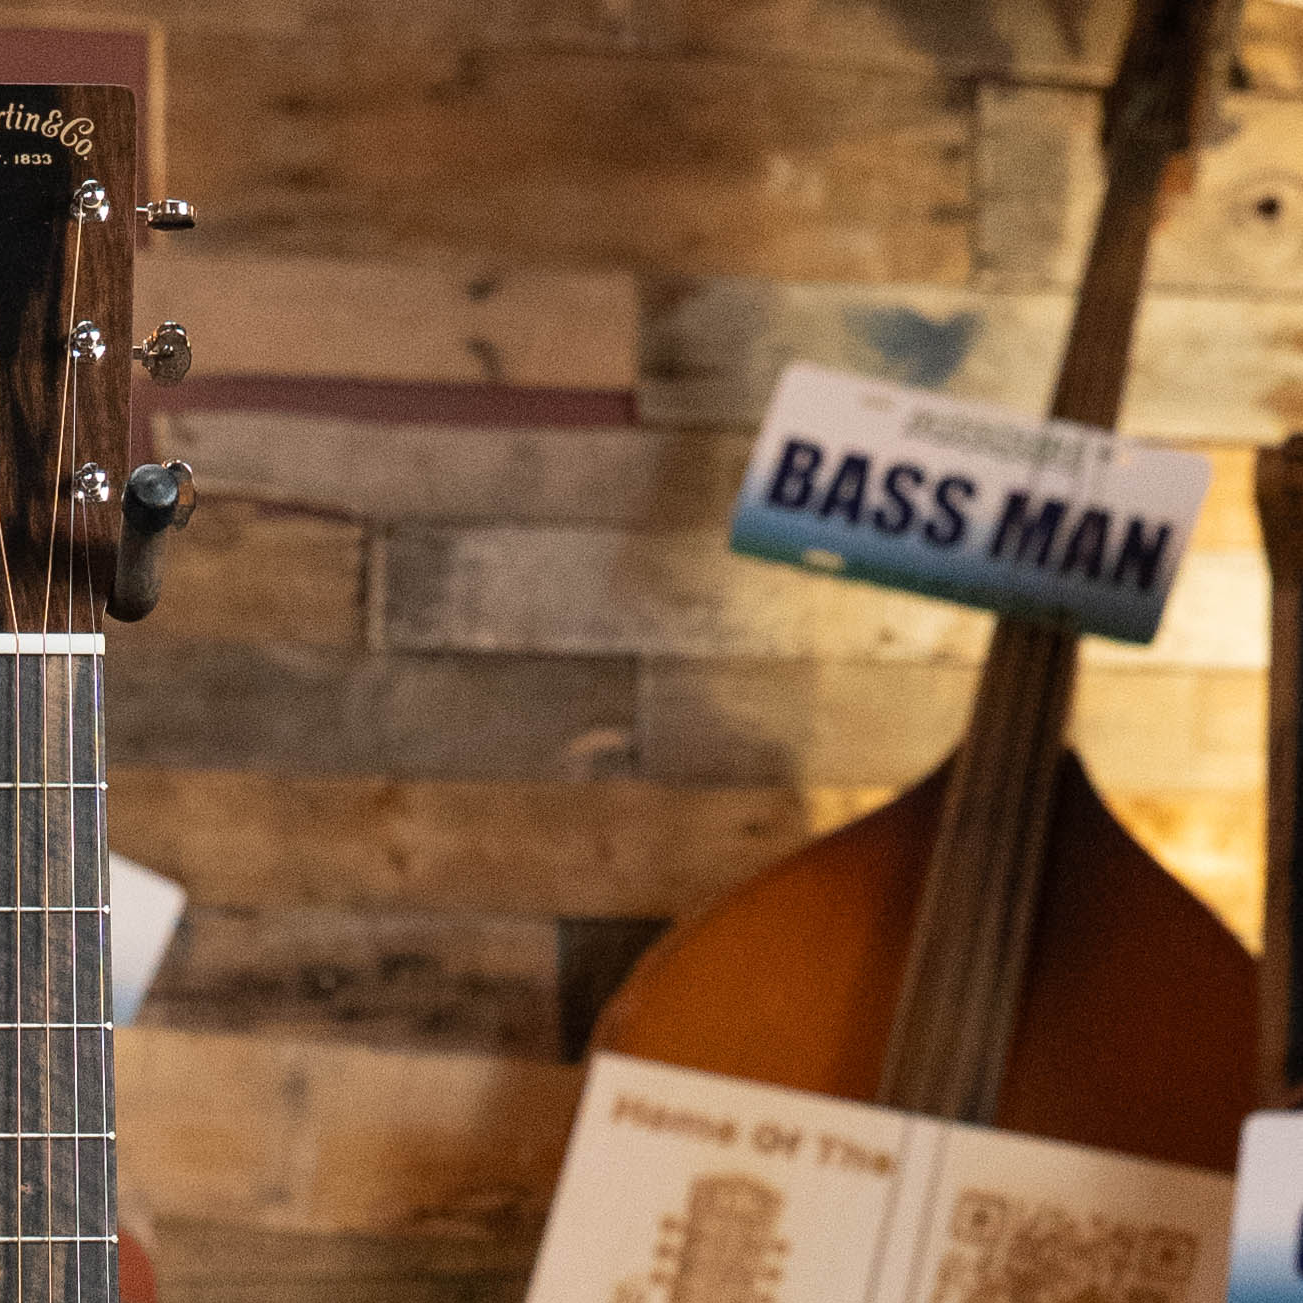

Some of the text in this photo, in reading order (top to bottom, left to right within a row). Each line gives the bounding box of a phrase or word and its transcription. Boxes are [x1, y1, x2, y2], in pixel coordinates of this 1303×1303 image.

[14, 153, 53, 165] 1833
[766, 434, 976, 551] BASS
[988, 488, 1172, 592] MAN
[609, 1090, 737, 1145] Home
[813, 1133, 898, 1178] The
